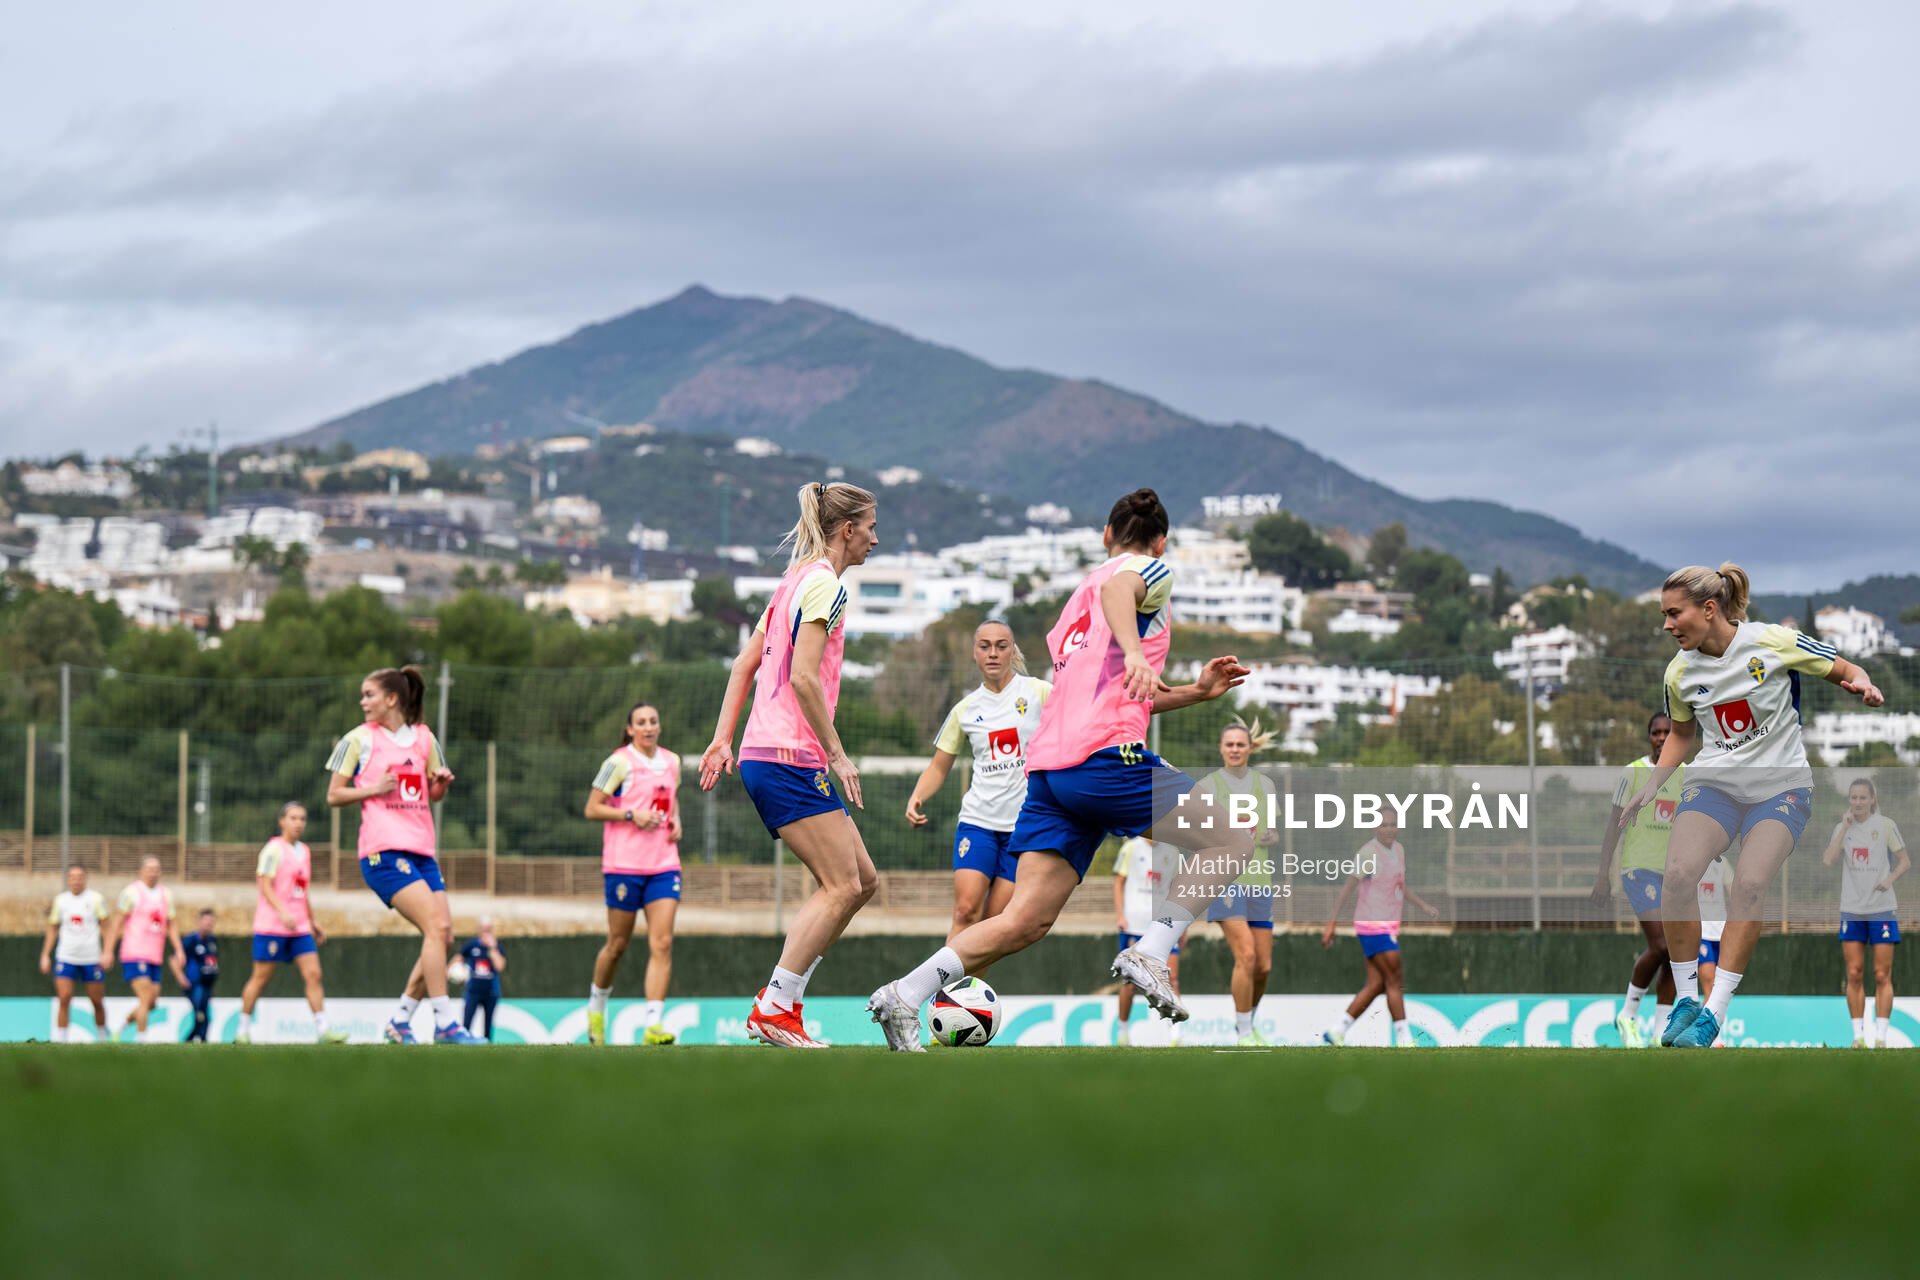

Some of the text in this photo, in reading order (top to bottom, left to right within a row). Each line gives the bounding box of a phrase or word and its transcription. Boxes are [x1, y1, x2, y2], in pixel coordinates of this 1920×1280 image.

[1201, 493, 1282, 517] THE SKY
[1015, 759, 1026, 767] SP
